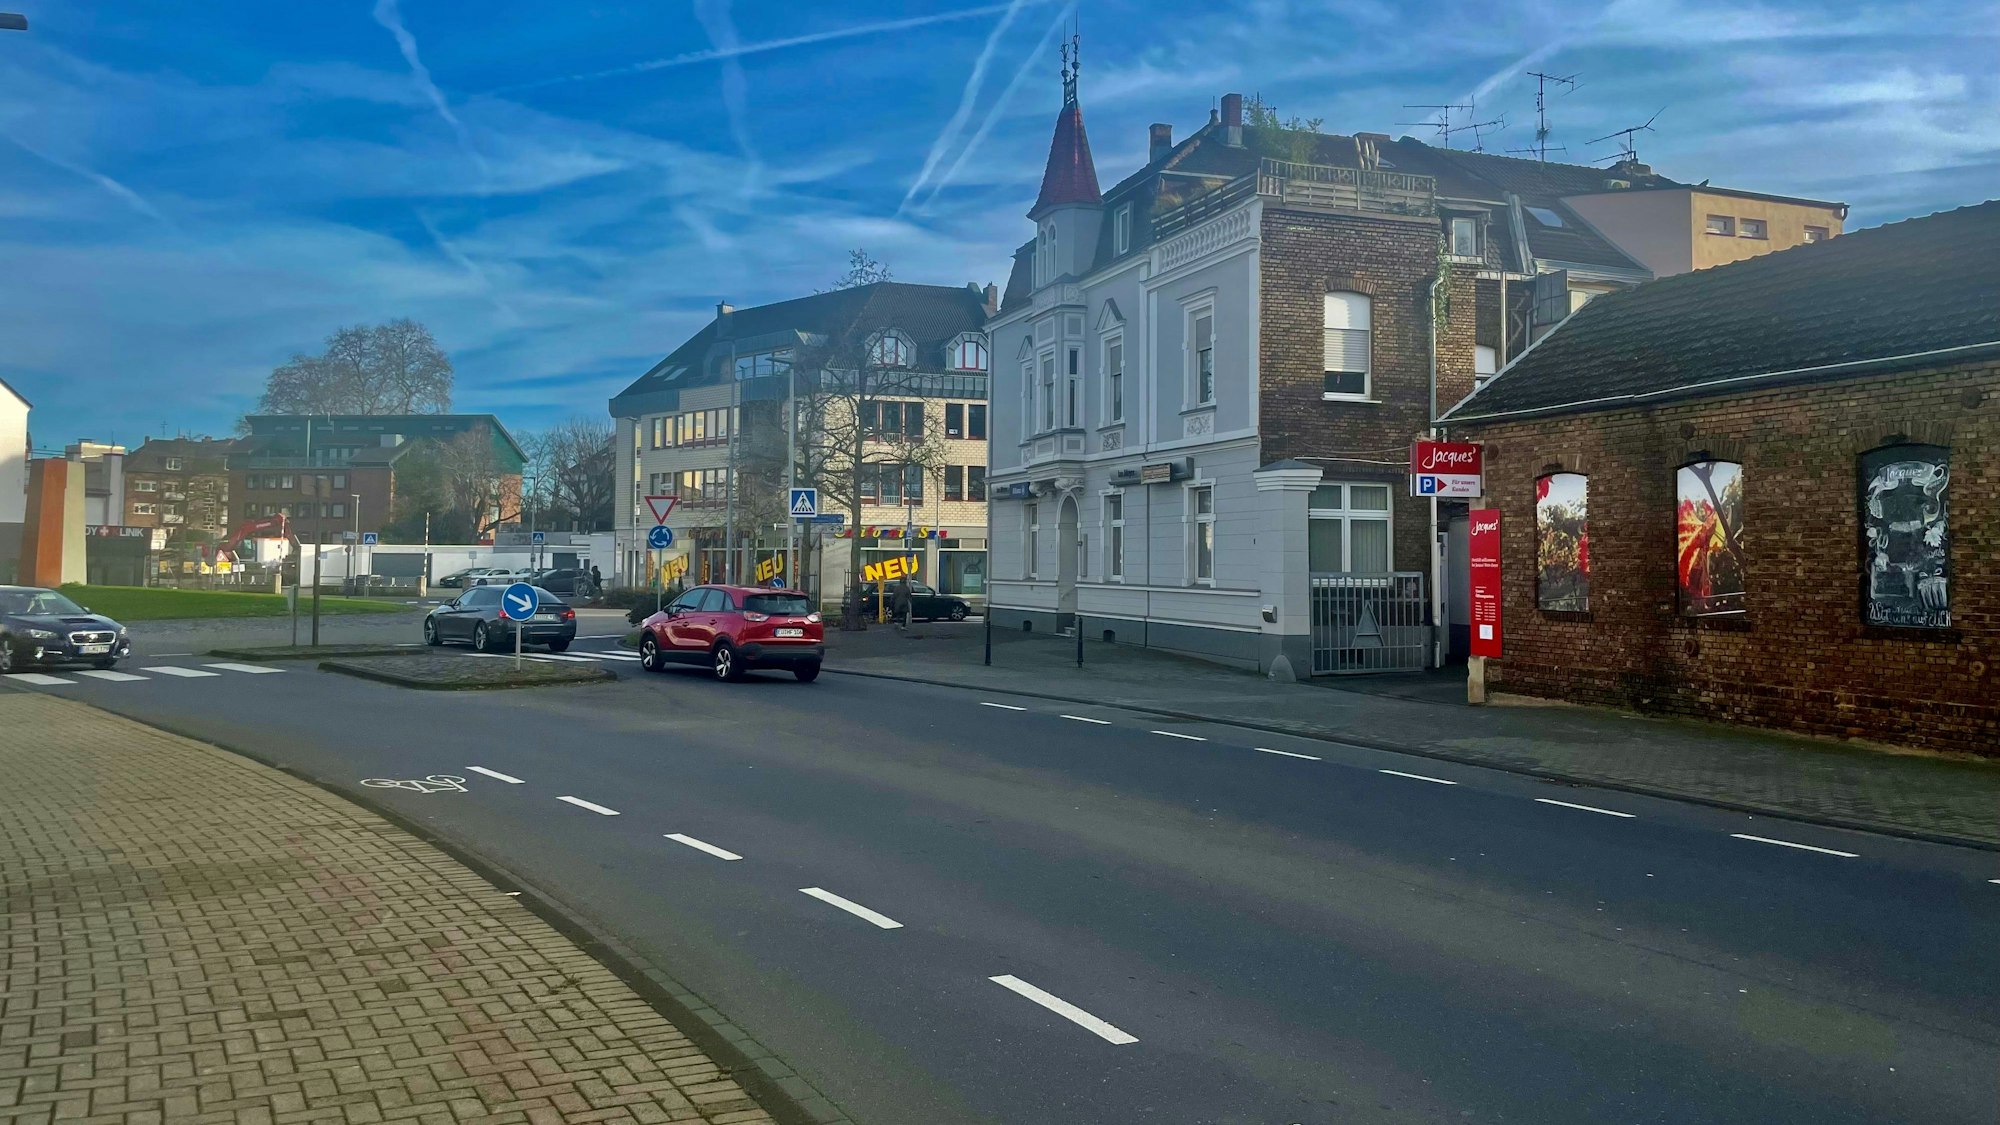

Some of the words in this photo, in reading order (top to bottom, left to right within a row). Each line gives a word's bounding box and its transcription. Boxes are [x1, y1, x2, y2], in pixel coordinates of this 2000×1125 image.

[1422, 447, 1477, 469] Jacques'
[1423, 478, 1433, 492] P
[1471, 519, 1498, 536] Jacques'
[864, 553, 919, 582] NEU
